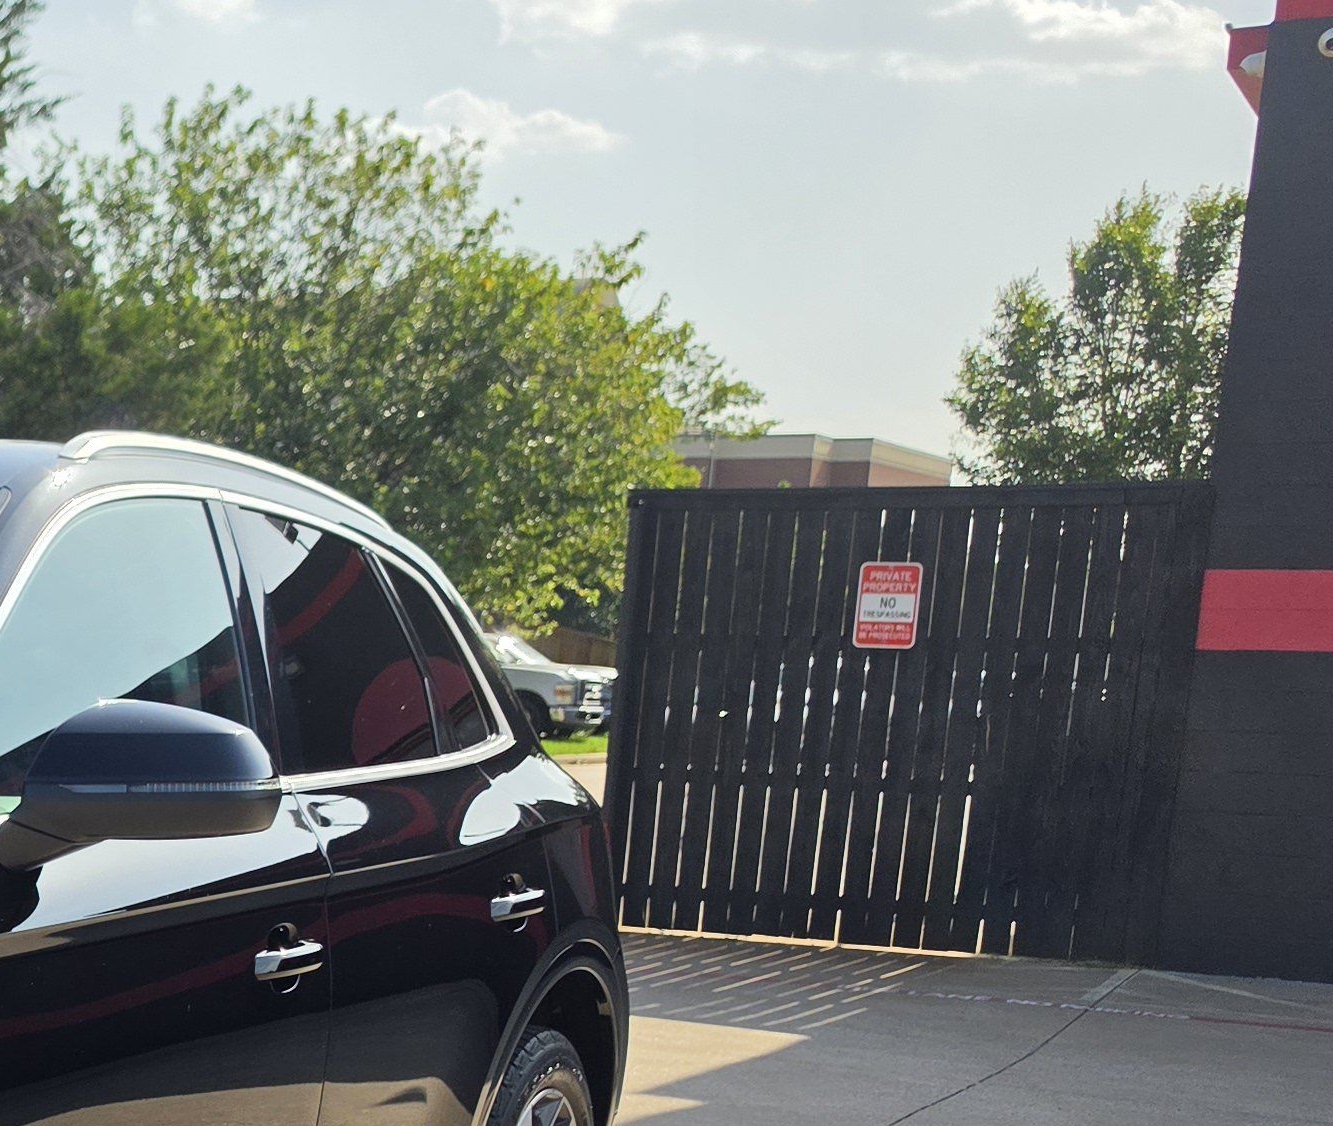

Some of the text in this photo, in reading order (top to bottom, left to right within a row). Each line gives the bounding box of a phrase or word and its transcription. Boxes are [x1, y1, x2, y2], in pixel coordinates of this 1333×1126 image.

[869, 570, 913, 582] PRIVATE
[862, 581, 917, 593] PROPERTY
[879, 597, 897, 609] NO
